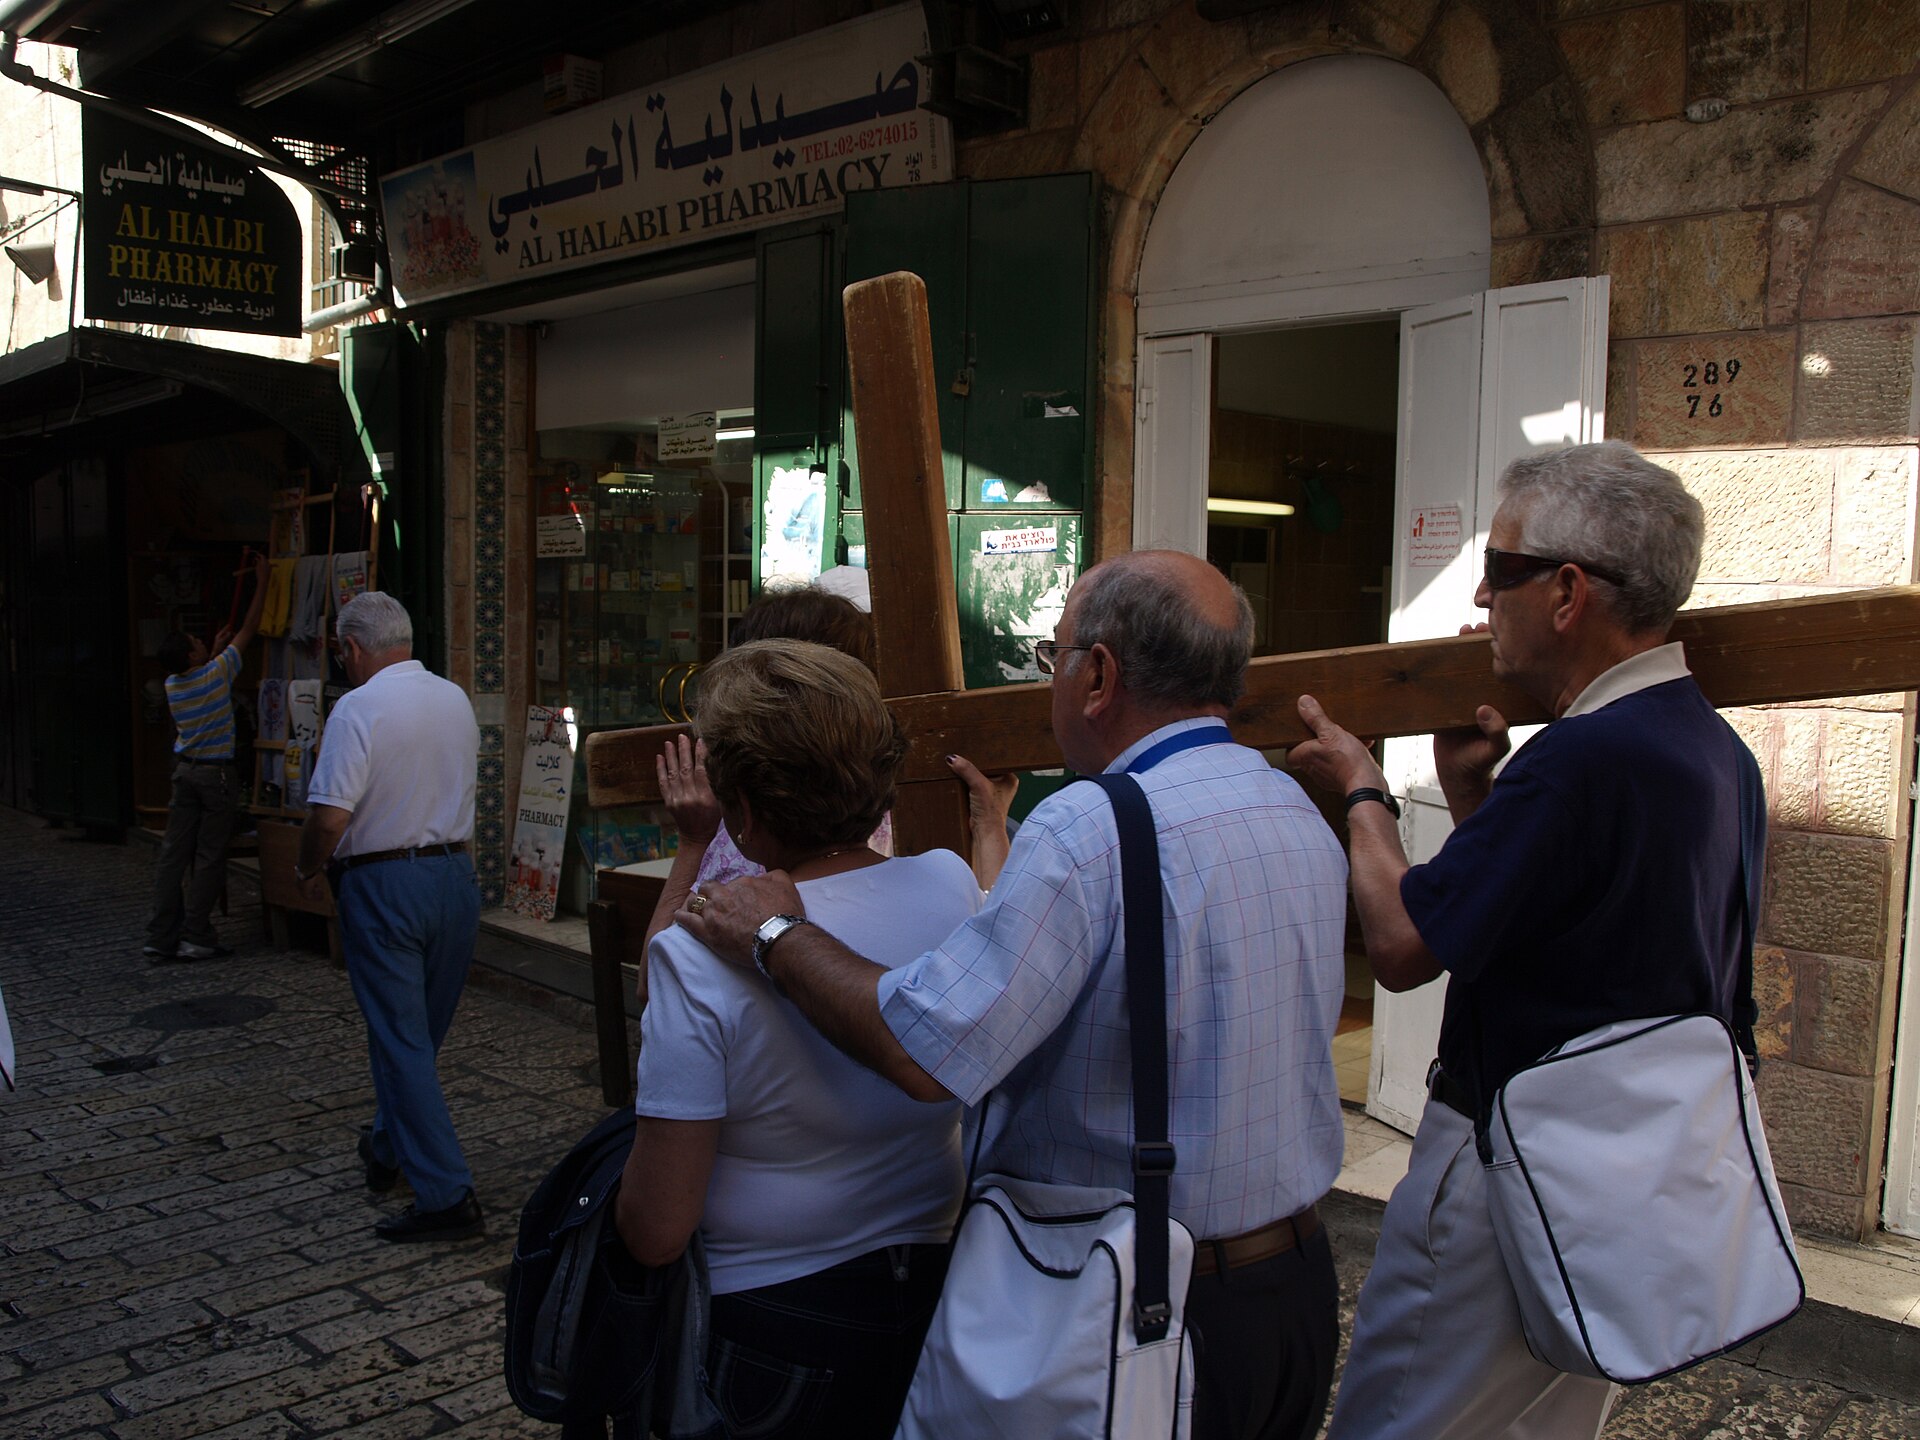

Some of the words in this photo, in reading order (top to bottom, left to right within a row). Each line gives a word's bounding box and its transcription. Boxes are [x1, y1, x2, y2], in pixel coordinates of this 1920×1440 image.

[646, 61, 919, 187] صيدلية
[100, 150, 172, 196] الحلبي
[176, 152, 246, 205] صيدلية
[487, 113, 638, 255] الحلبي
[908, 169, 921, 182] 78
[519, 237, 552, 269] AL
[559, 205, 670, 261] HALABI
[678, 153, 892, 234] PHARMACY
[116, 202, 160, 240] AL
[168, 209, 265, 254] HALBI
[107, 243, 279, 295] PHARMACY
[158, 293, 190, 309] غذاء
[198, 297, 234, 315] عطور
[1683, 359, 1741, 388] 289
[1686, 393, 1722, 418] 76
[1001, 541, 1021, 549] בבית
[1005, 534, 1018, 542] את
[1021, 530, 1045, 540] רוצים
[1024, 537, 1055, 546] פולארד
[519, 808, 566, 828] PHARMACY
